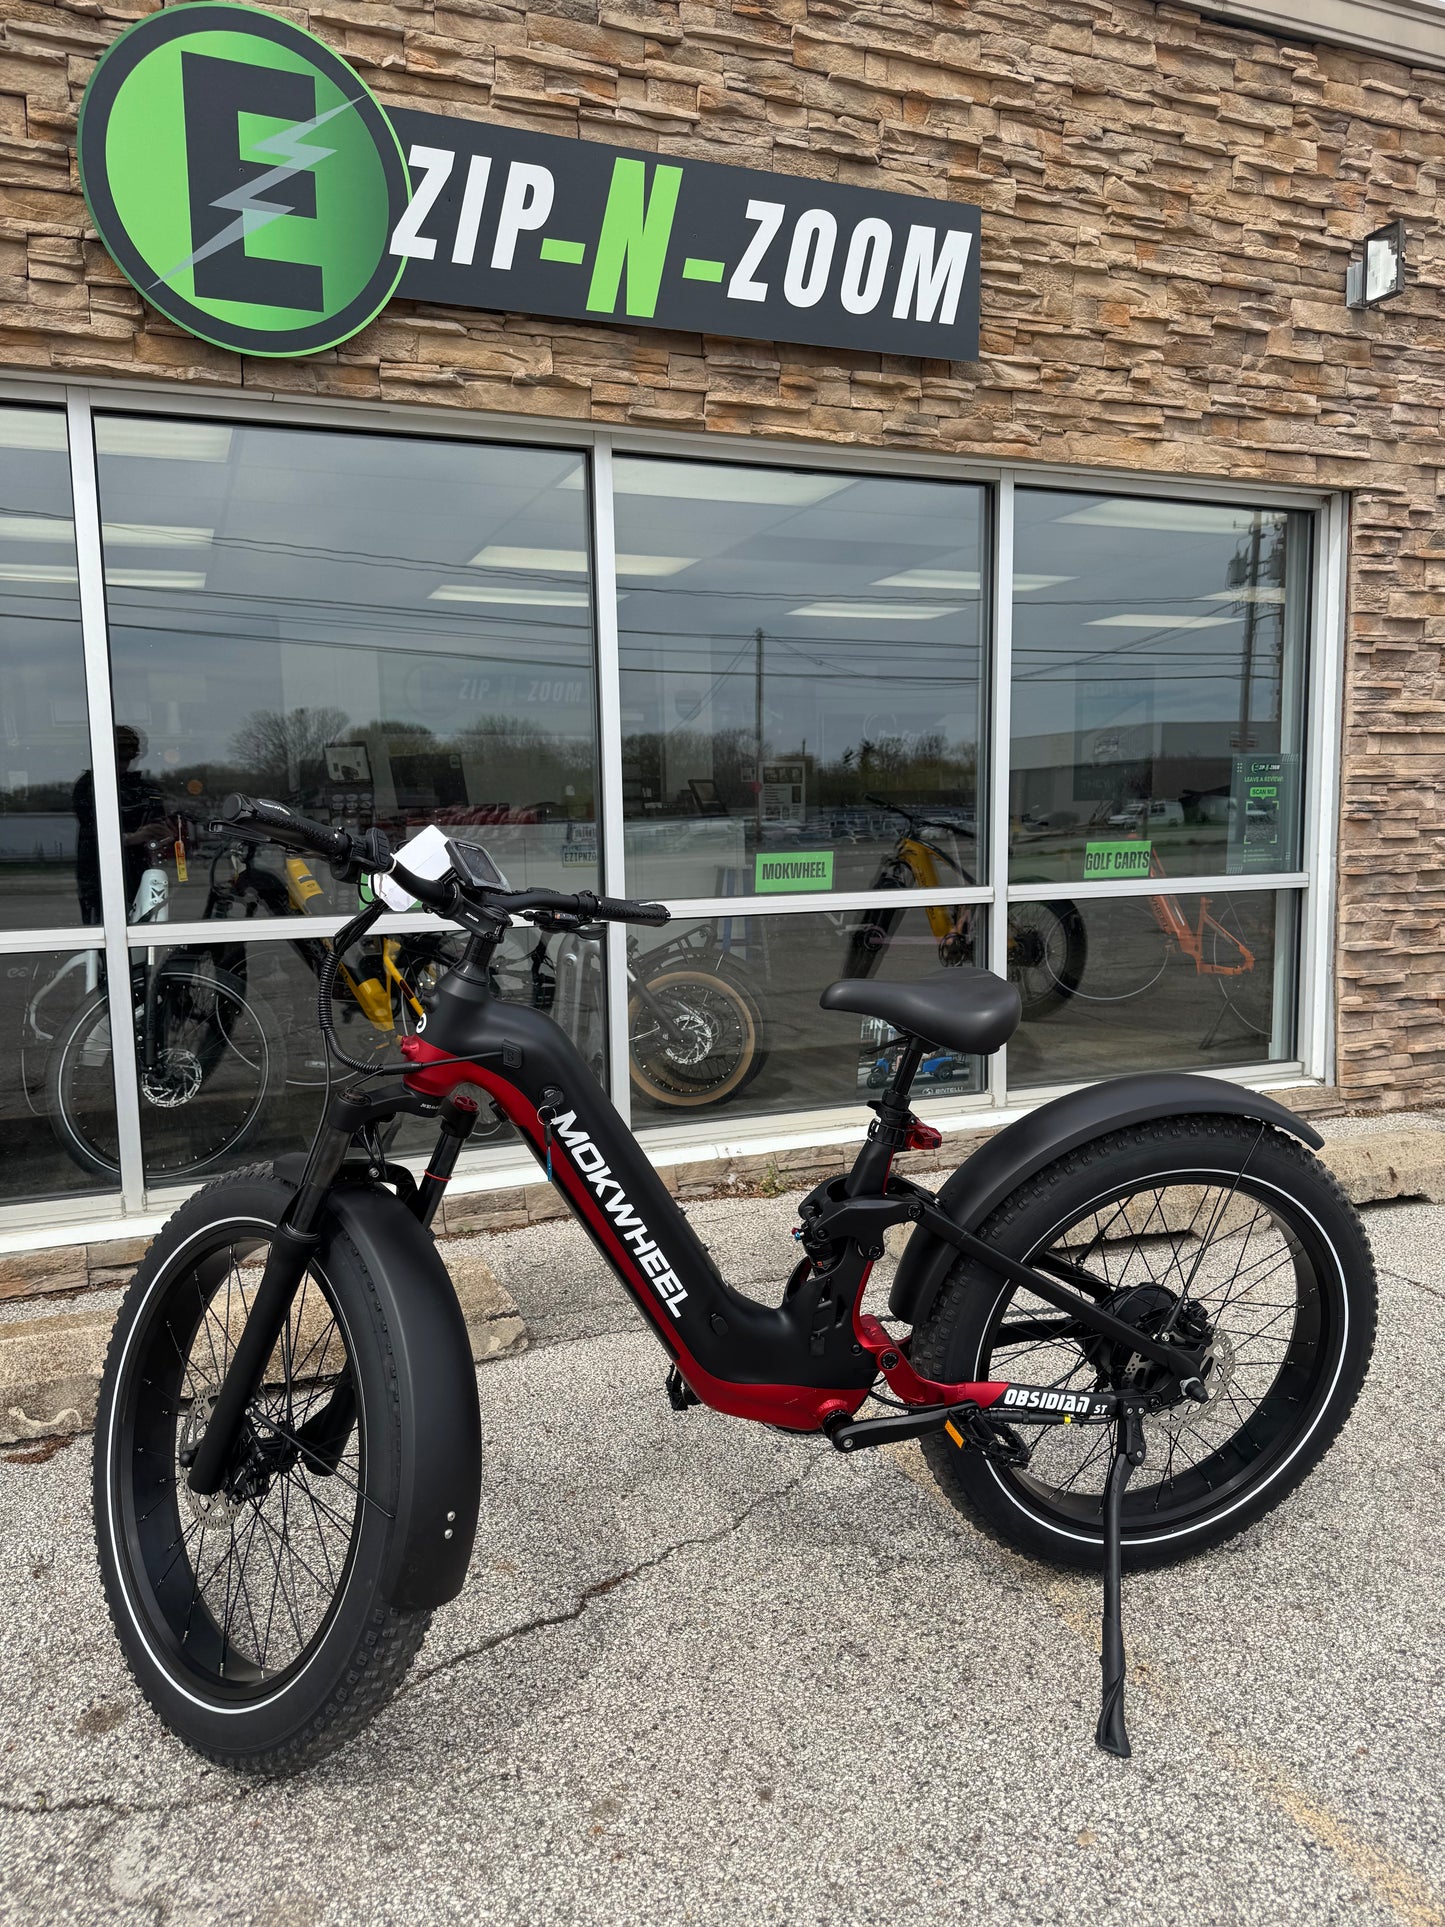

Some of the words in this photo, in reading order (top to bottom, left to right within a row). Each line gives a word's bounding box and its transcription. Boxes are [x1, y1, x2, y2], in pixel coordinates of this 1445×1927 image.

[388, 145, 974, 326] ZIP-N-ZOOM
[1244, 775, 1259, 783] LEAVE
[1252, 788, 1266, 796] SCAN
[762, 861, 827, 880] MOKWHEEL
[1085, 852, 1113, 871] GOLF
[1114, 850, 1150, 870] CARTS
[551, 1109, 689, 1318] MOKWHEEL
[1003, 1388, 1091, 1413] OBSIDIAN
[1094, 1404, 1108, 1414] ST
